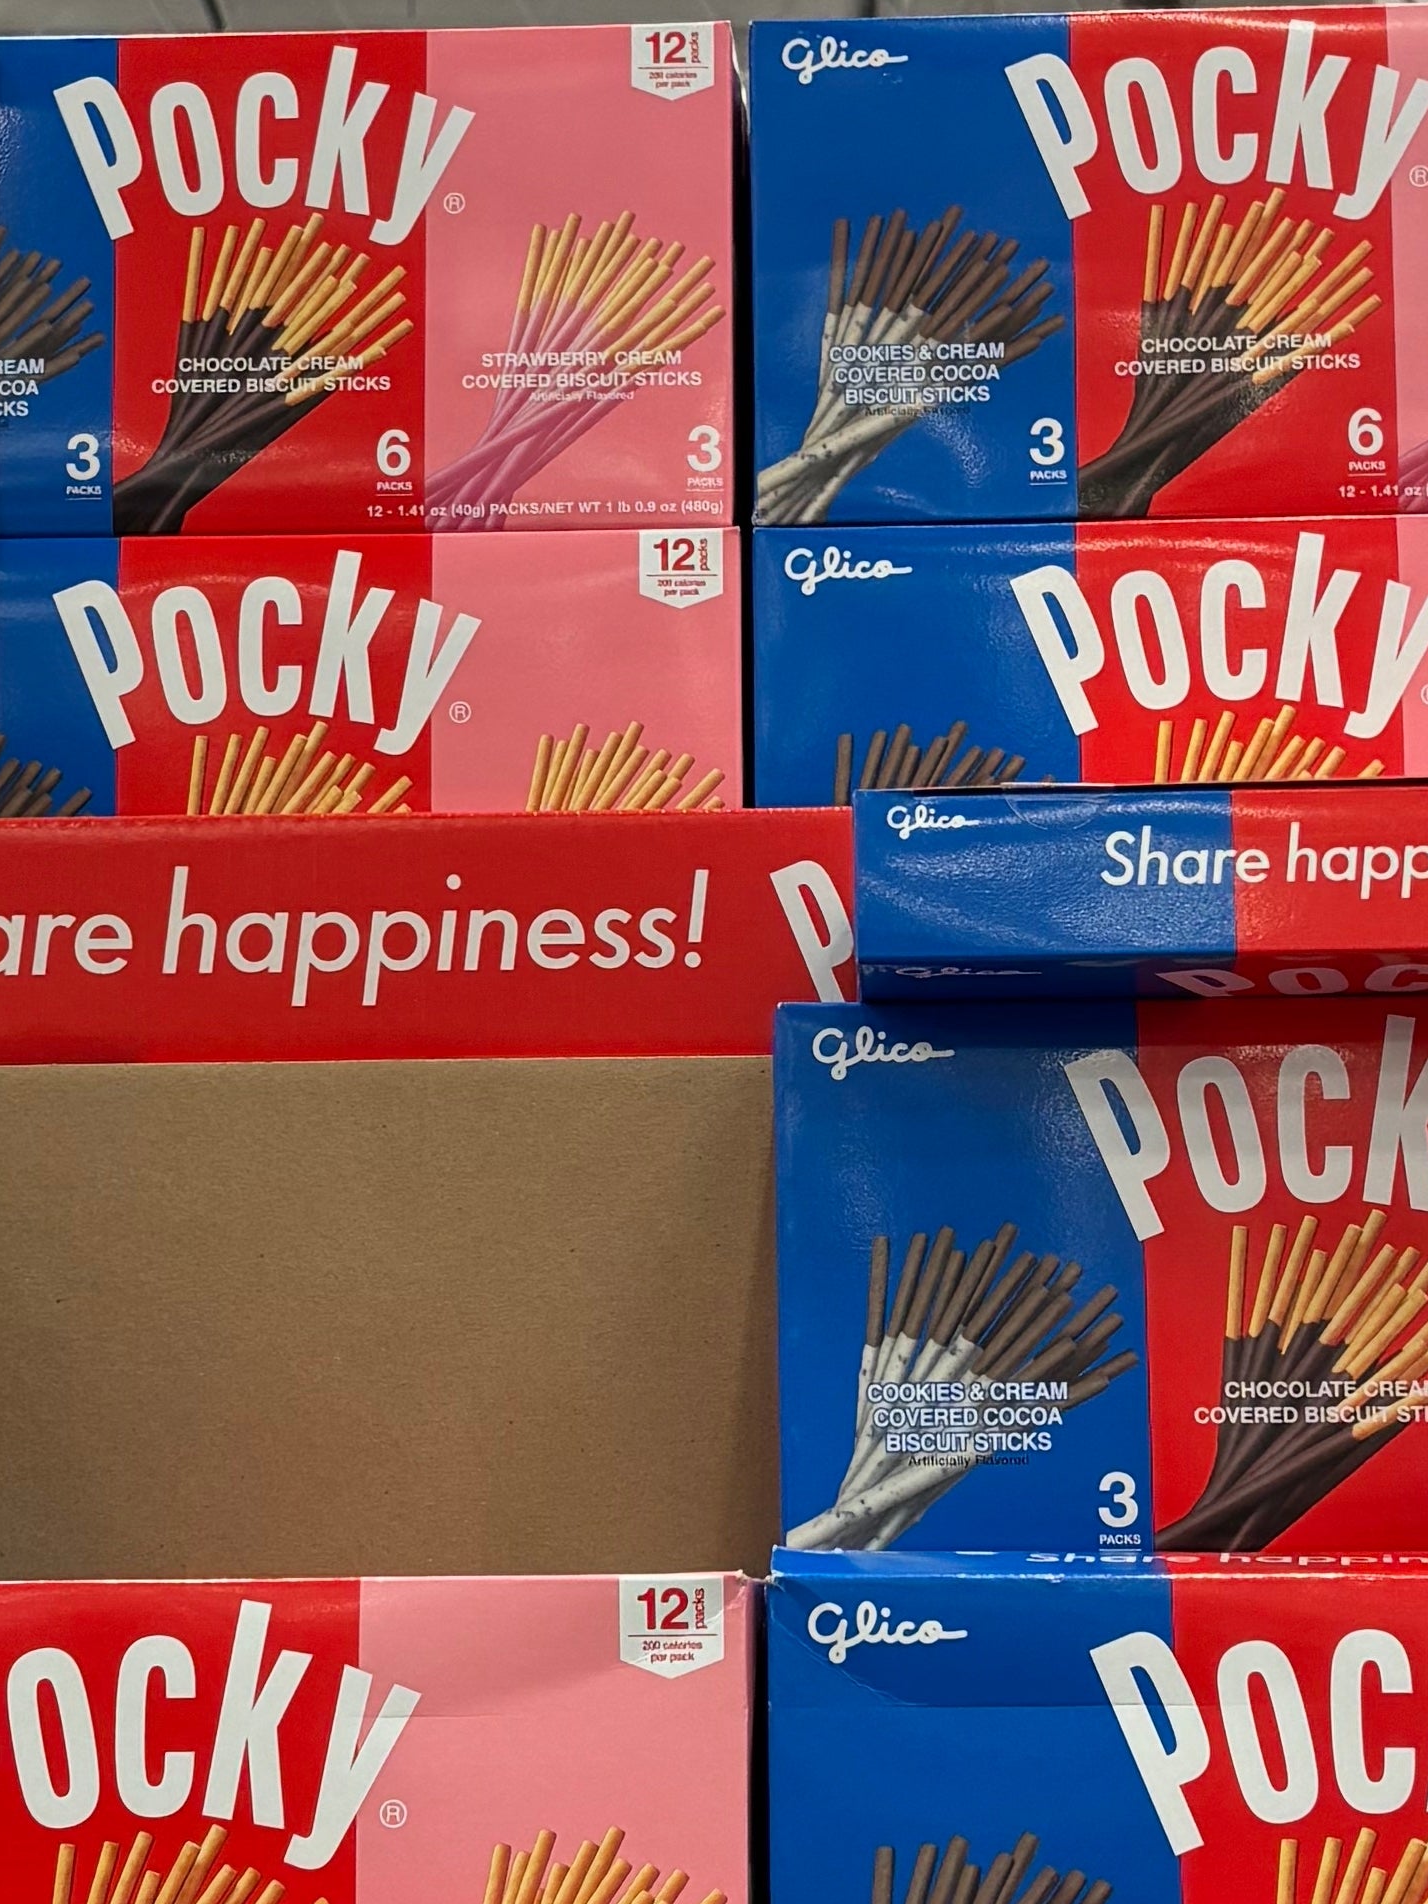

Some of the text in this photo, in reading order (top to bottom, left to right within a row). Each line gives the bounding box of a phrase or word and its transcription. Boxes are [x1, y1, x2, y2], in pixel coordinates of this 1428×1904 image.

[645, 32, 686, 64] 12
[782, 36, 908, 84] Glico
[53, 45, 475, 245] Pocky
[152, 376, 391, 394] COVERED BISCUIT STICKS
[179, 356, 363, 373] CHOCOLATE CREAM
[784, 546, 912, 595] Glico
[53, 549, 481, 756] Pocky
[887, 805, 979, 839] Glico
[1101, 825, 1270, 886] Share
[162, 866, 709, 1007] happiness!
[812, 1026, 955, 1081] Glico
[867, 1381, 1068, 1402] COOKIES & CREAM
[874, 1407, 1062, 1427] COVERED COCOA
[886, 1432, 1052, 1453] BISCUIT STICKS
[1098, 1472, 1139, 1528] 3
[807, 1601, 967, 1664] Glico
